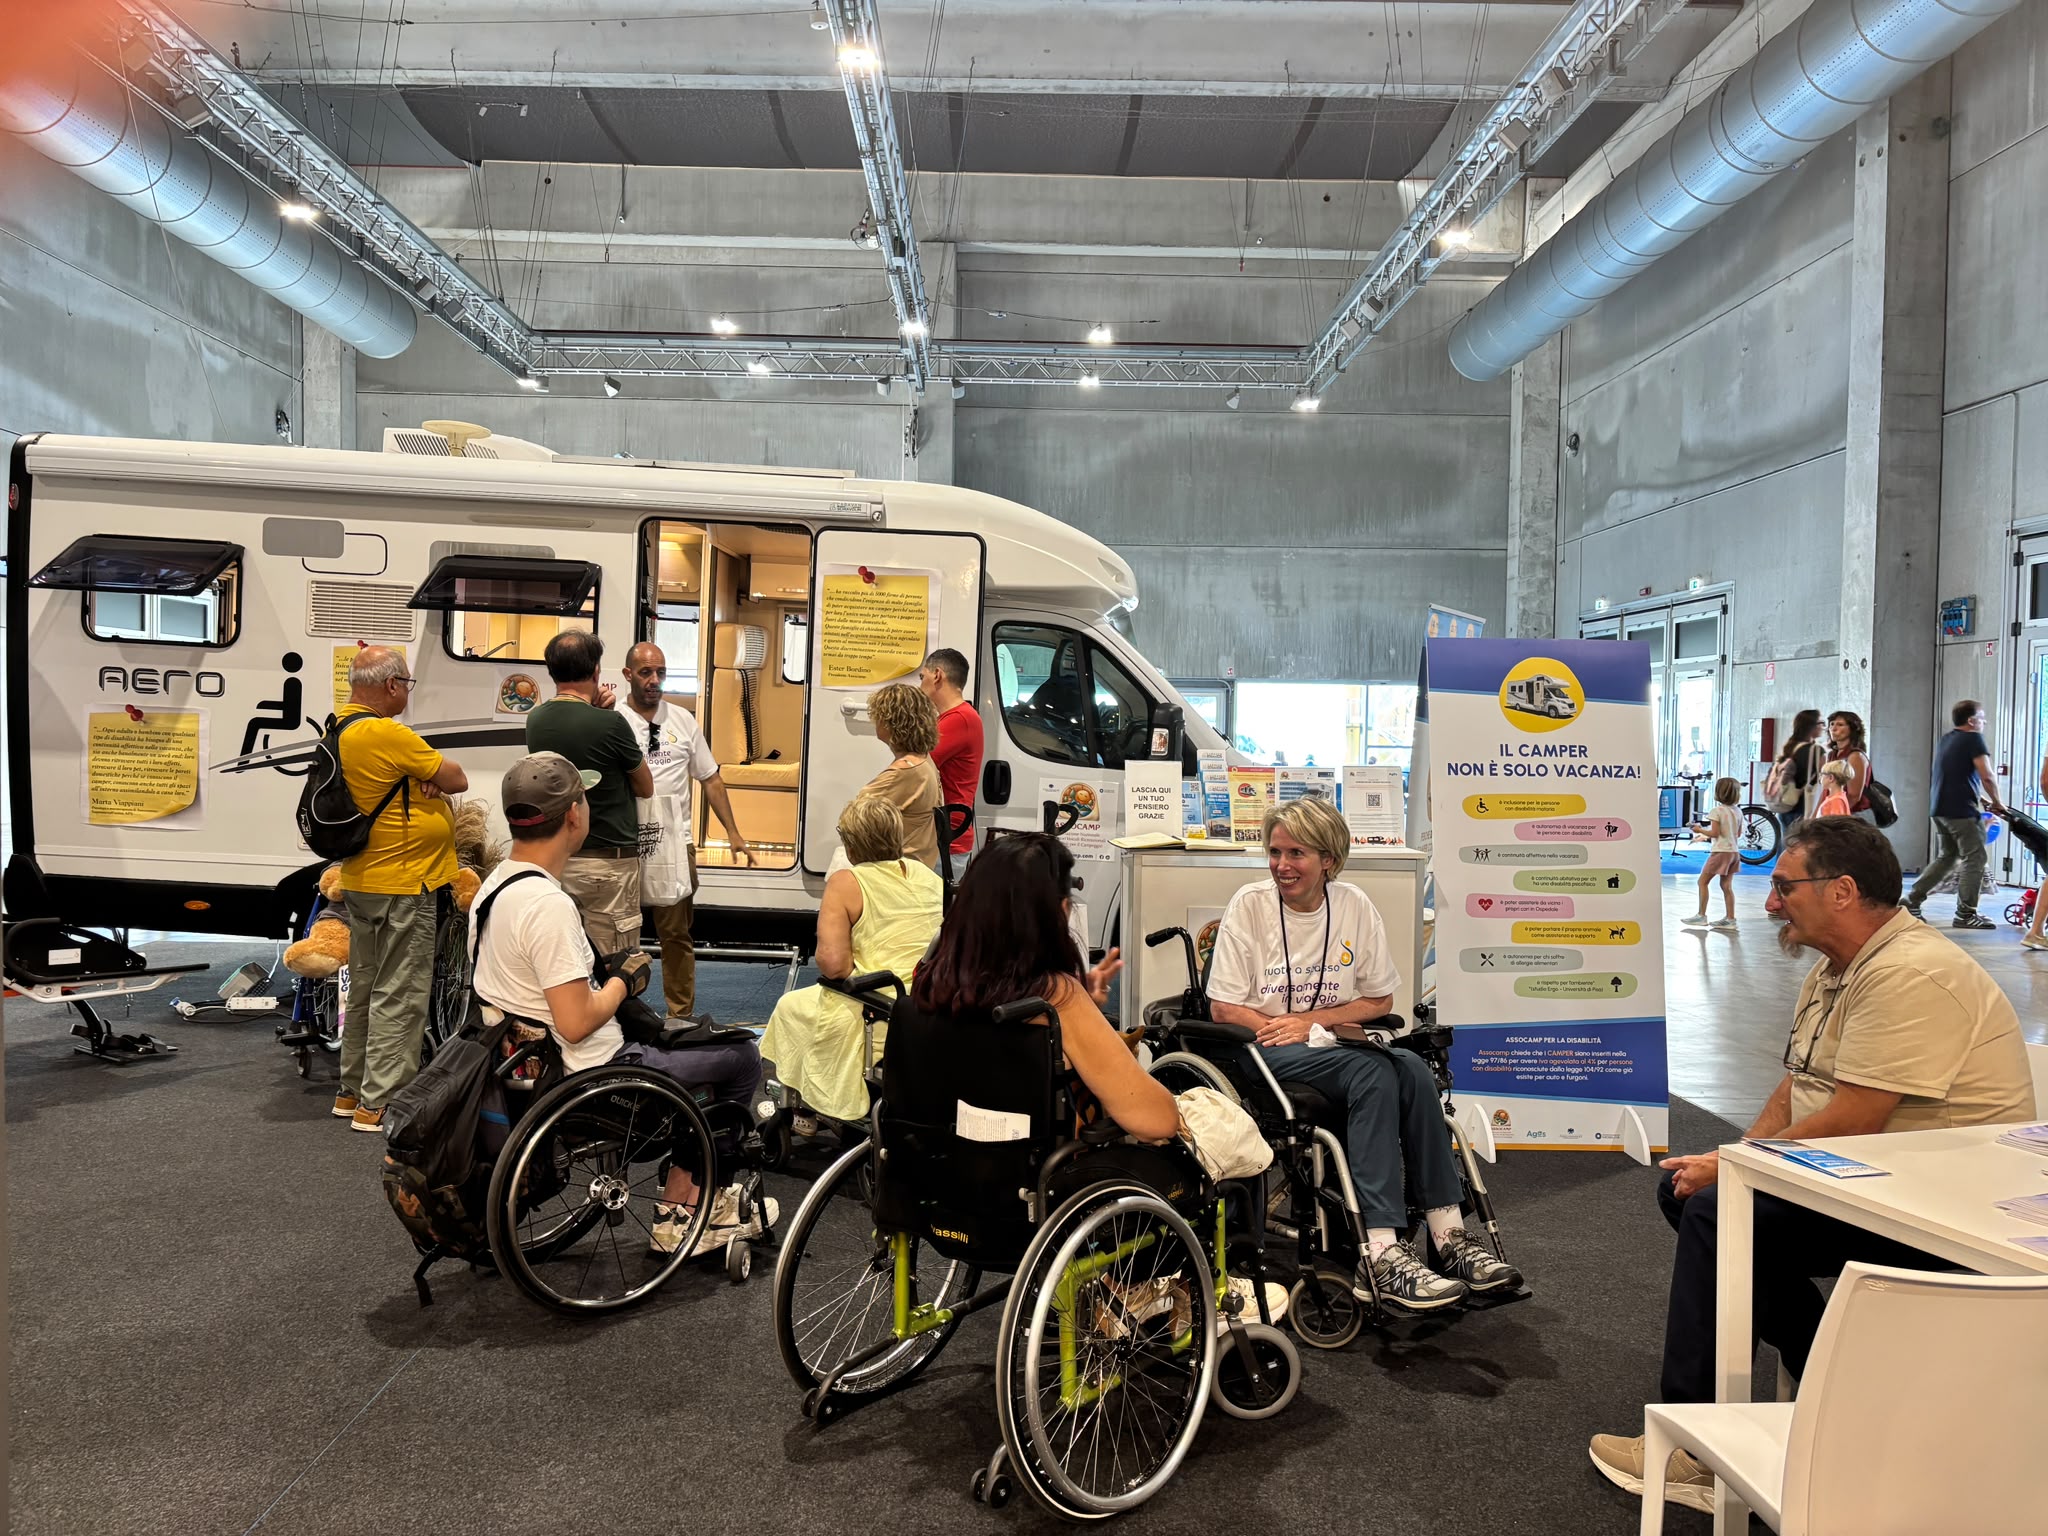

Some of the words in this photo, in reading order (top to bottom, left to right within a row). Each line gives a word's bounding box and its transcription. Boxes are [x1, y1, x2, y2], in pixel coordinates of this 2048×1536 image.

[1500, 744, 1513, 757] IL
[1518, 744, 1588, 758] CAMPER
[1447, 763, 1484, 776] NON
[1489, 760, 1498, 776] È
[1504, 764, 1548, 777] SOLO
[1554, 765, 1641, 779] VACANZA!
[1295, 966, 1302, 974] a
[1567, 1036, 1601, 1044] DISABILITÀ
[1479, 1049, 1510, 1057] Assocamp
[1471, 1057, 1489, 1065] legge
[1549, 1057, 1580, 1066] agevolata
[1566, 1065, 1583, 1074] legge
[1623, 1066, 1634, 1074] già
[1566, 1073, 1588, 1082] furgoni.
